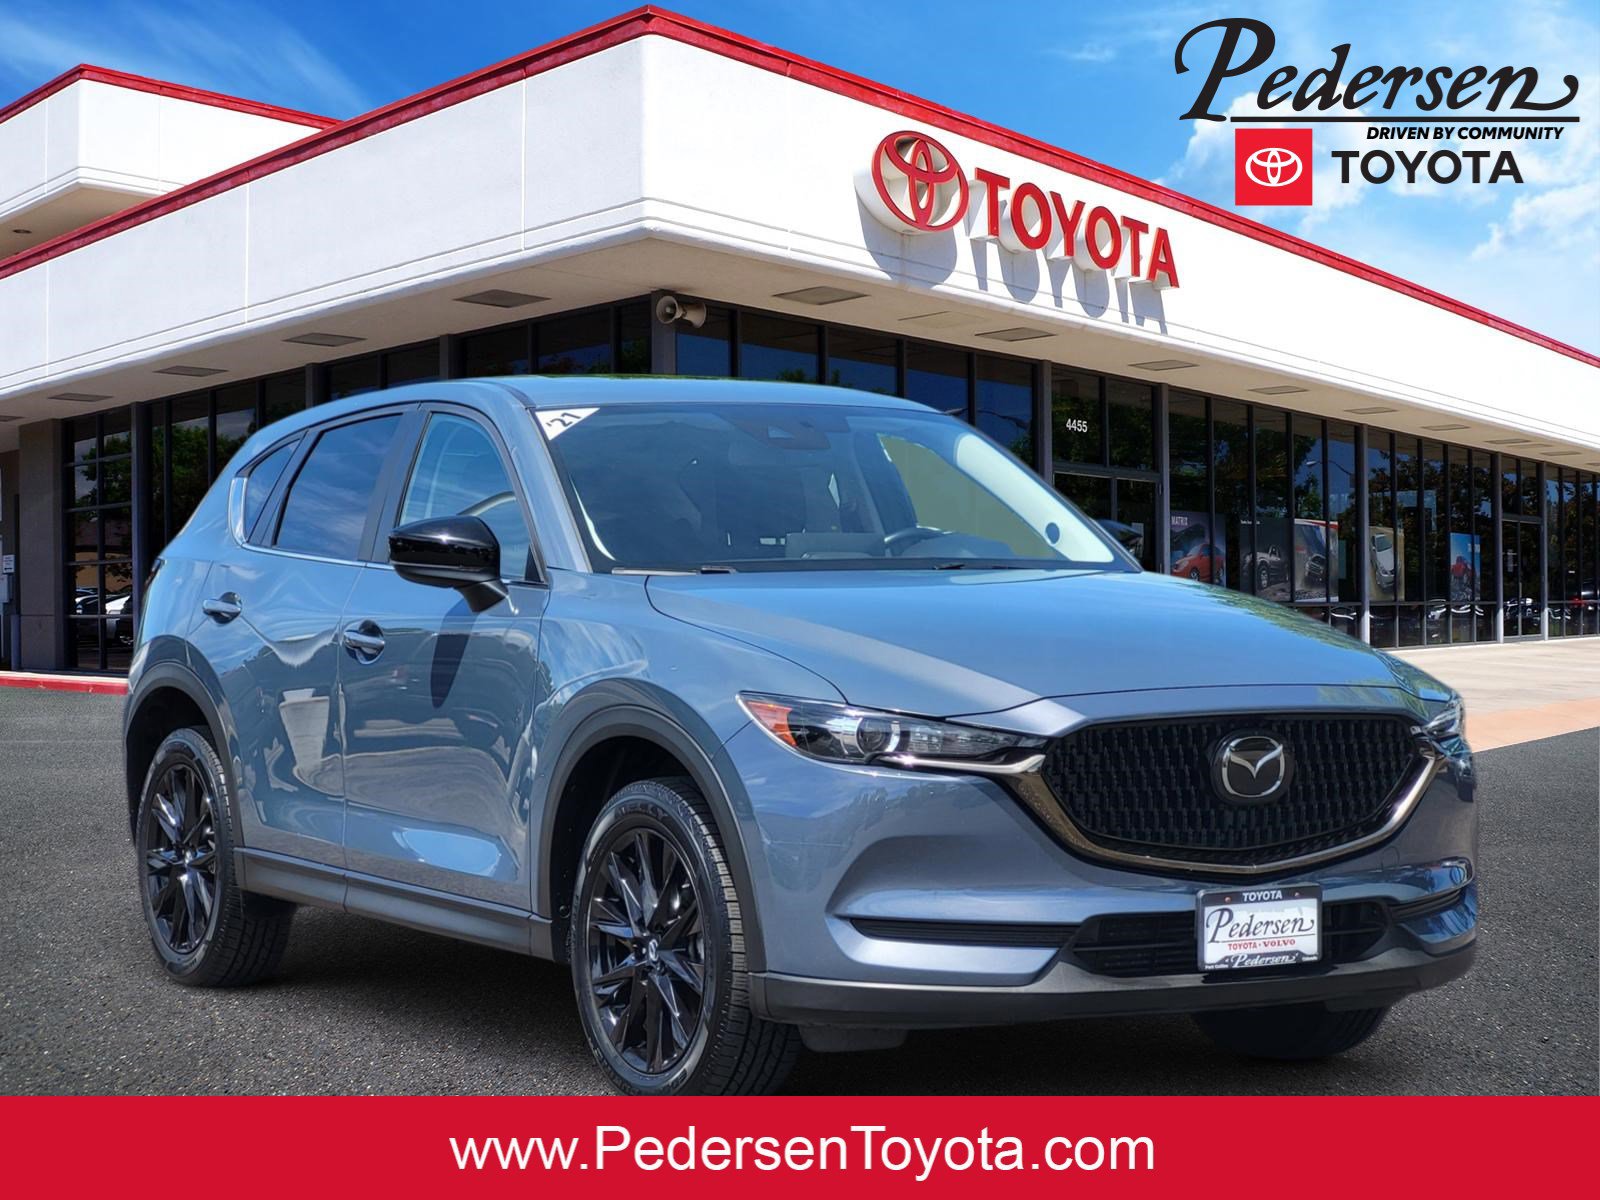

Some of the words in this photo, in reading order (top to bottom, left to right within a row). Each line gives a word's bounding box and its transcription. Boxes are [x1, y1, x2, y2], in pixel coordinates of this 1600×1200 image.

[974, 167, 1180, 288] TOYOTA
[1065, 418, 1088, 433] 4455
[1242, 890, 1283, 902] TOYOTA
[1206, 907, 1315, 944] Pedersen
[1228, 941, 1258, 951] TOYOTA
[1263, 938, 1296, 948] VOLVO
[1232, 952, 1297, 968] Pedersen
